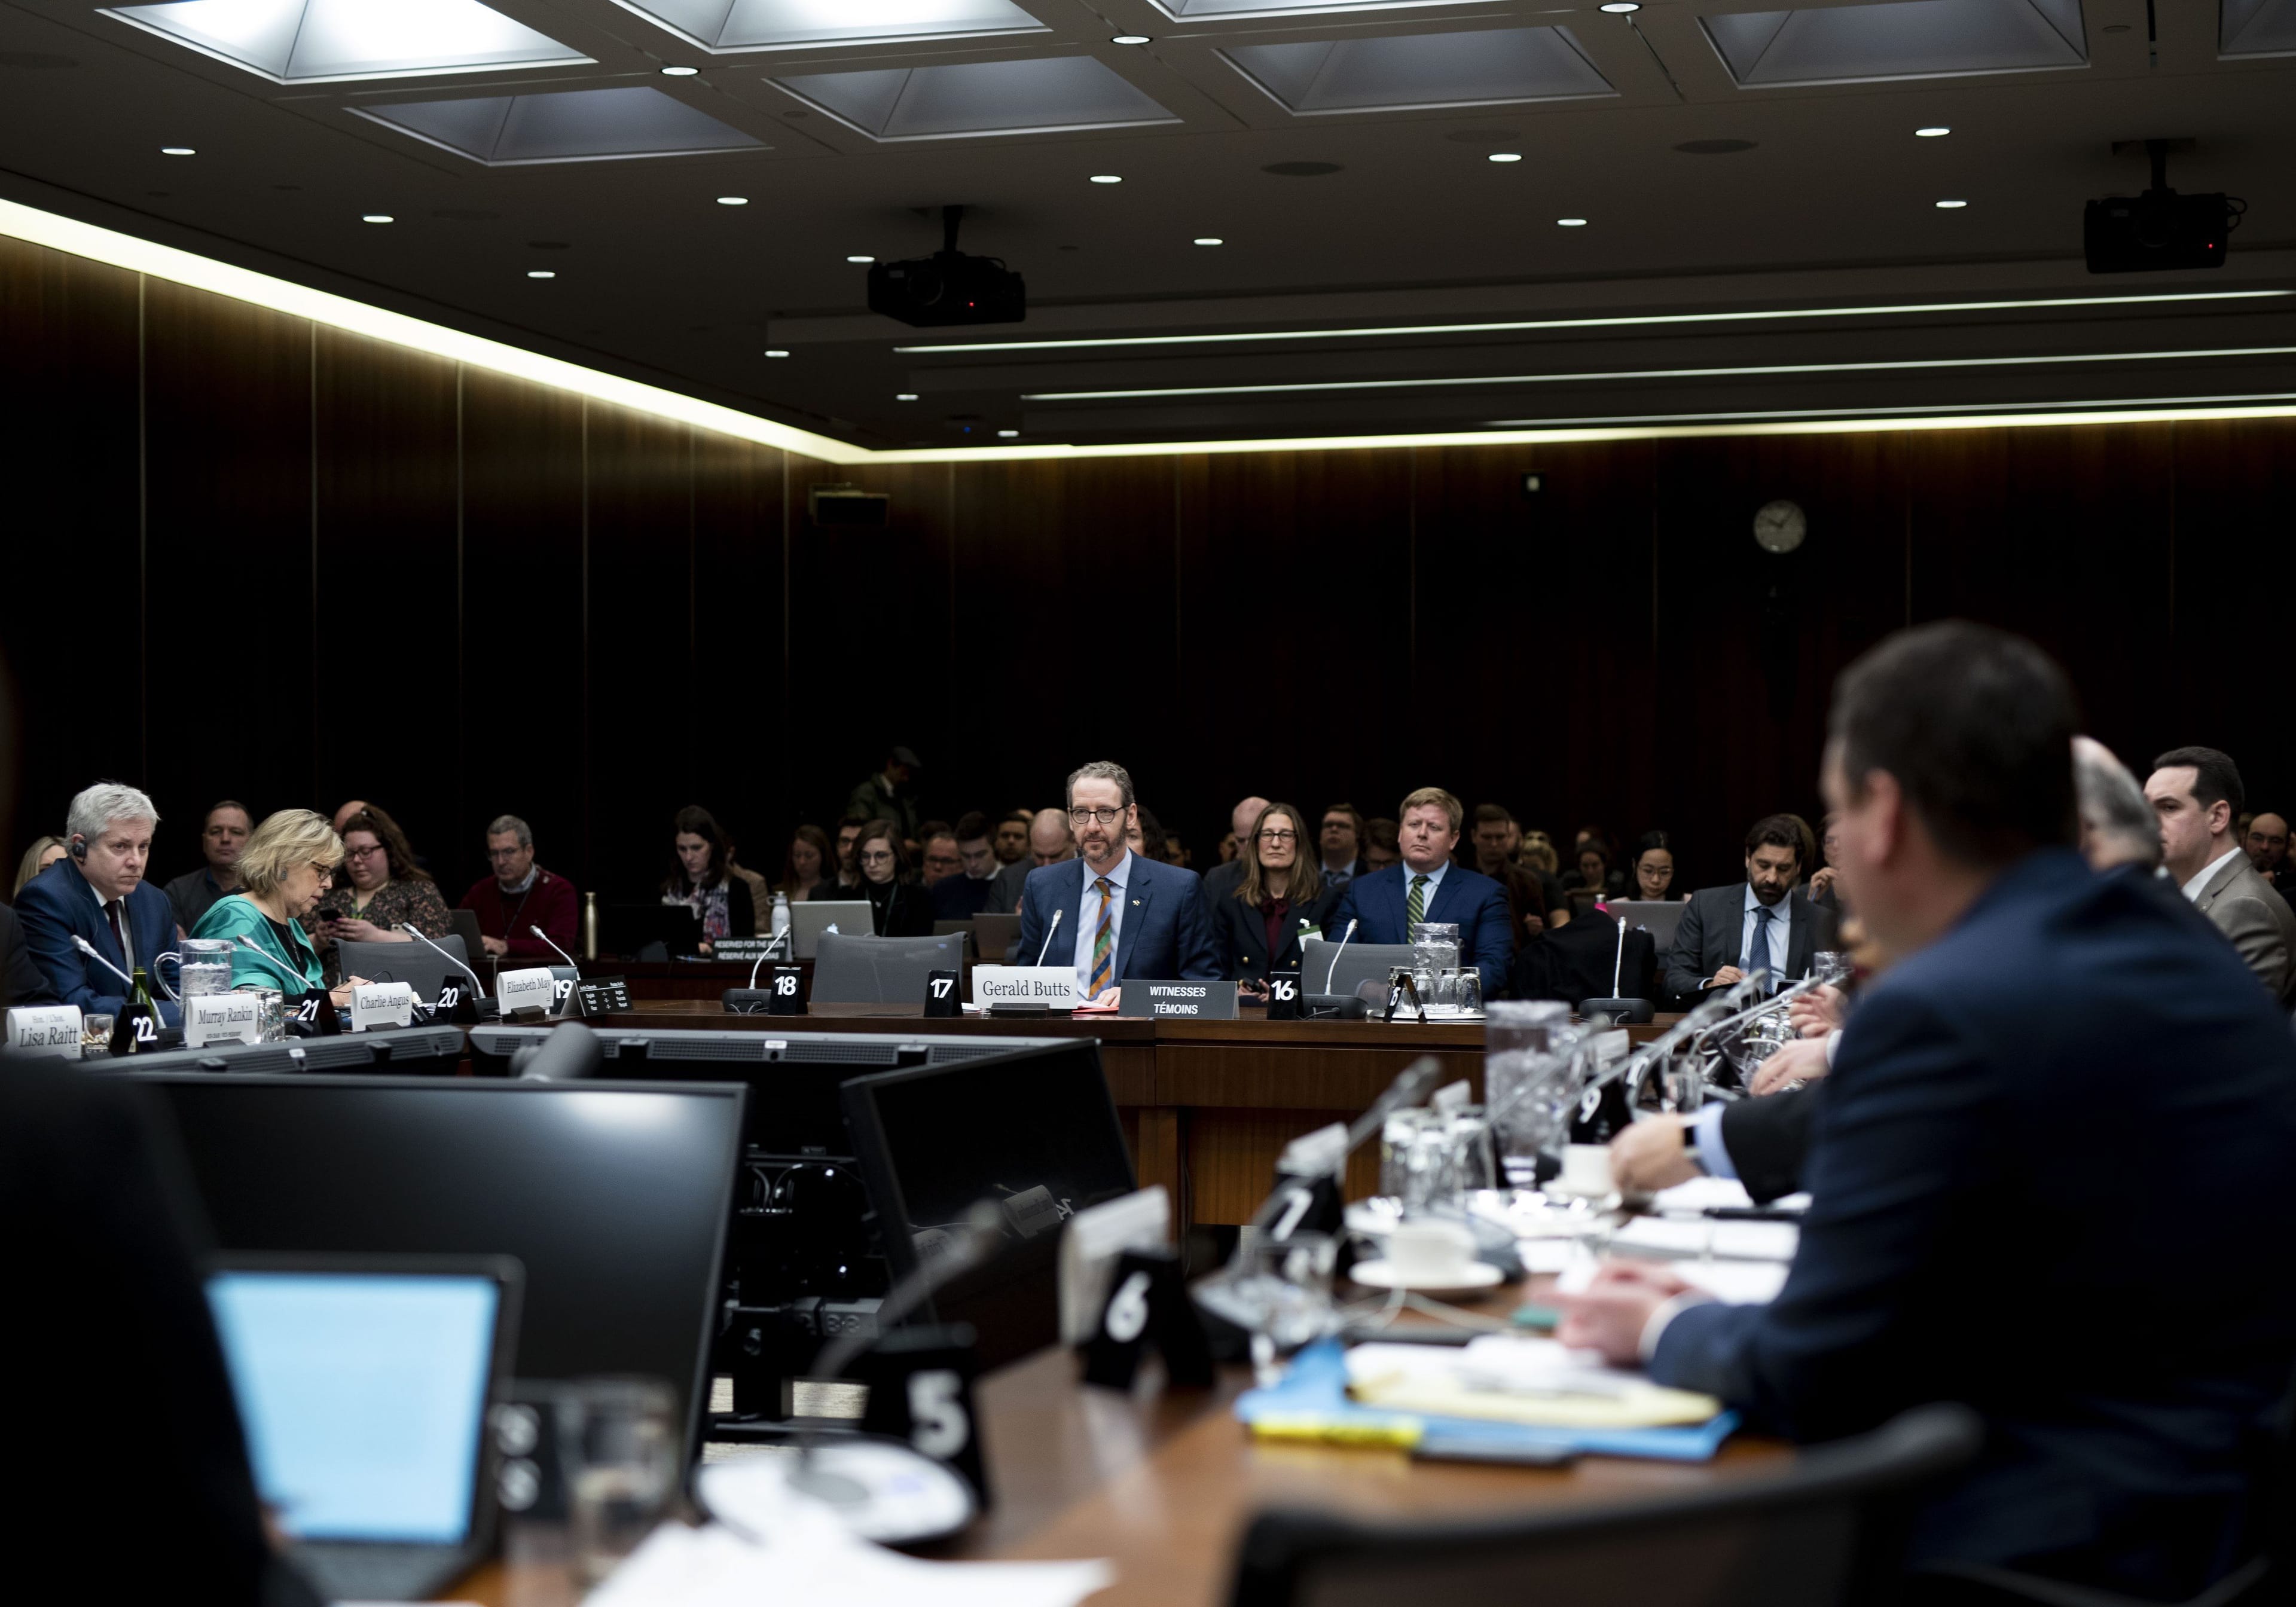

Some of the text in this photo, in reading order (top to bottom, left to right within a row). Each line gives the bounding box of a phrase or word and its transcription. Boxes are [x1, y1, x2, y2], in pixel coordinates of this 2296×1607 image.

[744, 940, 756, 949] FOR
[756, 940, 767, 949] THE
[507, 977, 551, 994] Elizabeth May
[553, 979, 574, 999] 19
[774, 976, 796, 995] 18
[930, 978, 953, 998] 17
[982, 980, 1070, 997] Gerald Butts
[1149, 986, 1207, 997] WITNESSES
[1271, 980, 1294, 1001] 16
[361, 994, 409, 1010] Charlie Angus
[438, 987, 458, 1008] 20
[198, 1006, 253, 1027] Murray Rankin
[297, 999, 320, 1022] 21
[1153, 1001, 1199, 1015] TÉMOINS
[19, 1025, 78, 1047] Lisa Raitt
[133, 1016, 158, 1042] 22
[1578, 1087, 1602, 1123] 9
[1105, 1269, 1152, 1343] 6
[906, 1368, 969, 1461] 5
